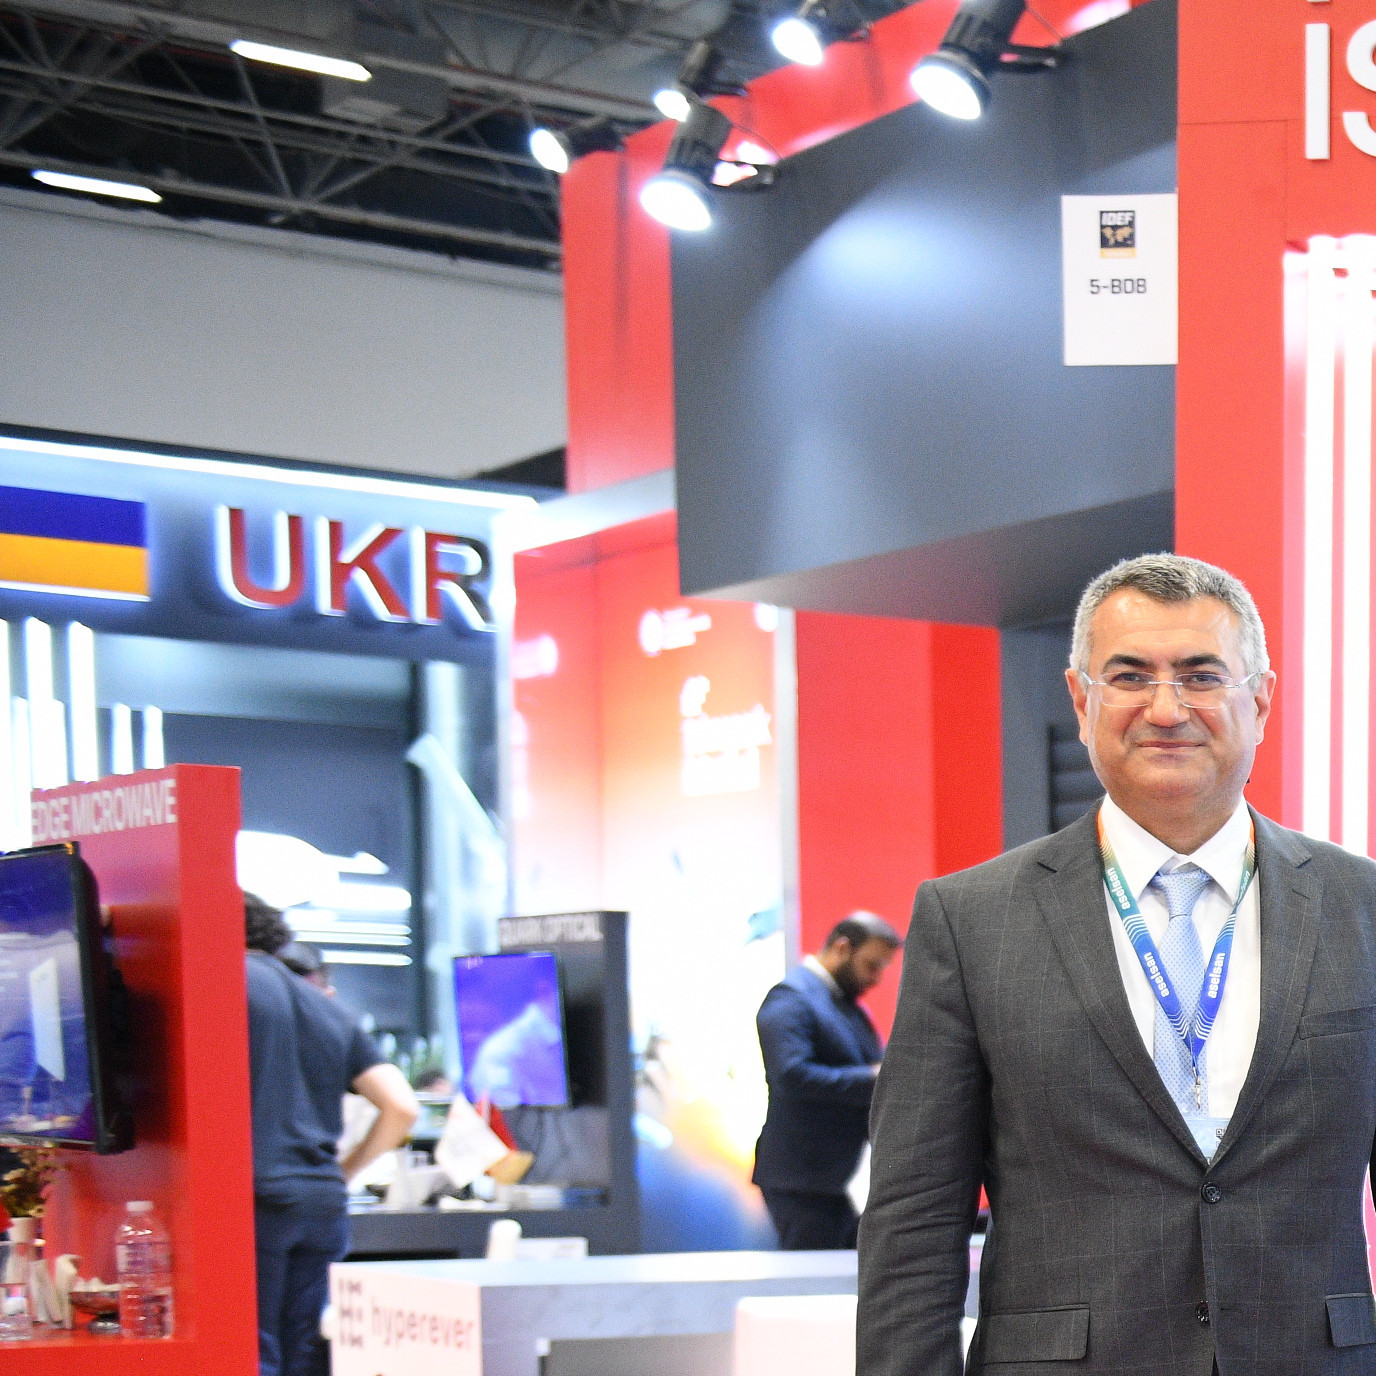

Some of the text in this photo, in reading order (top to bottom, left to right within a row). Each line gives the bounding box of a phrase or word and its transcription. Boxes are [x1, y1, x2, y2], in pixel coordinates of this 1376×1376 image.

[1101, 212, 1135, 226] IDEF
[71, 778, 177, 836] MICROWAVE
[1107, 867, 1131, 910] aselsan
[1143, 952, 1170, 998] aselsan
[1207, 952, 1226, 999] aselsan
[370, 1296, 475, 1351] hyperever
